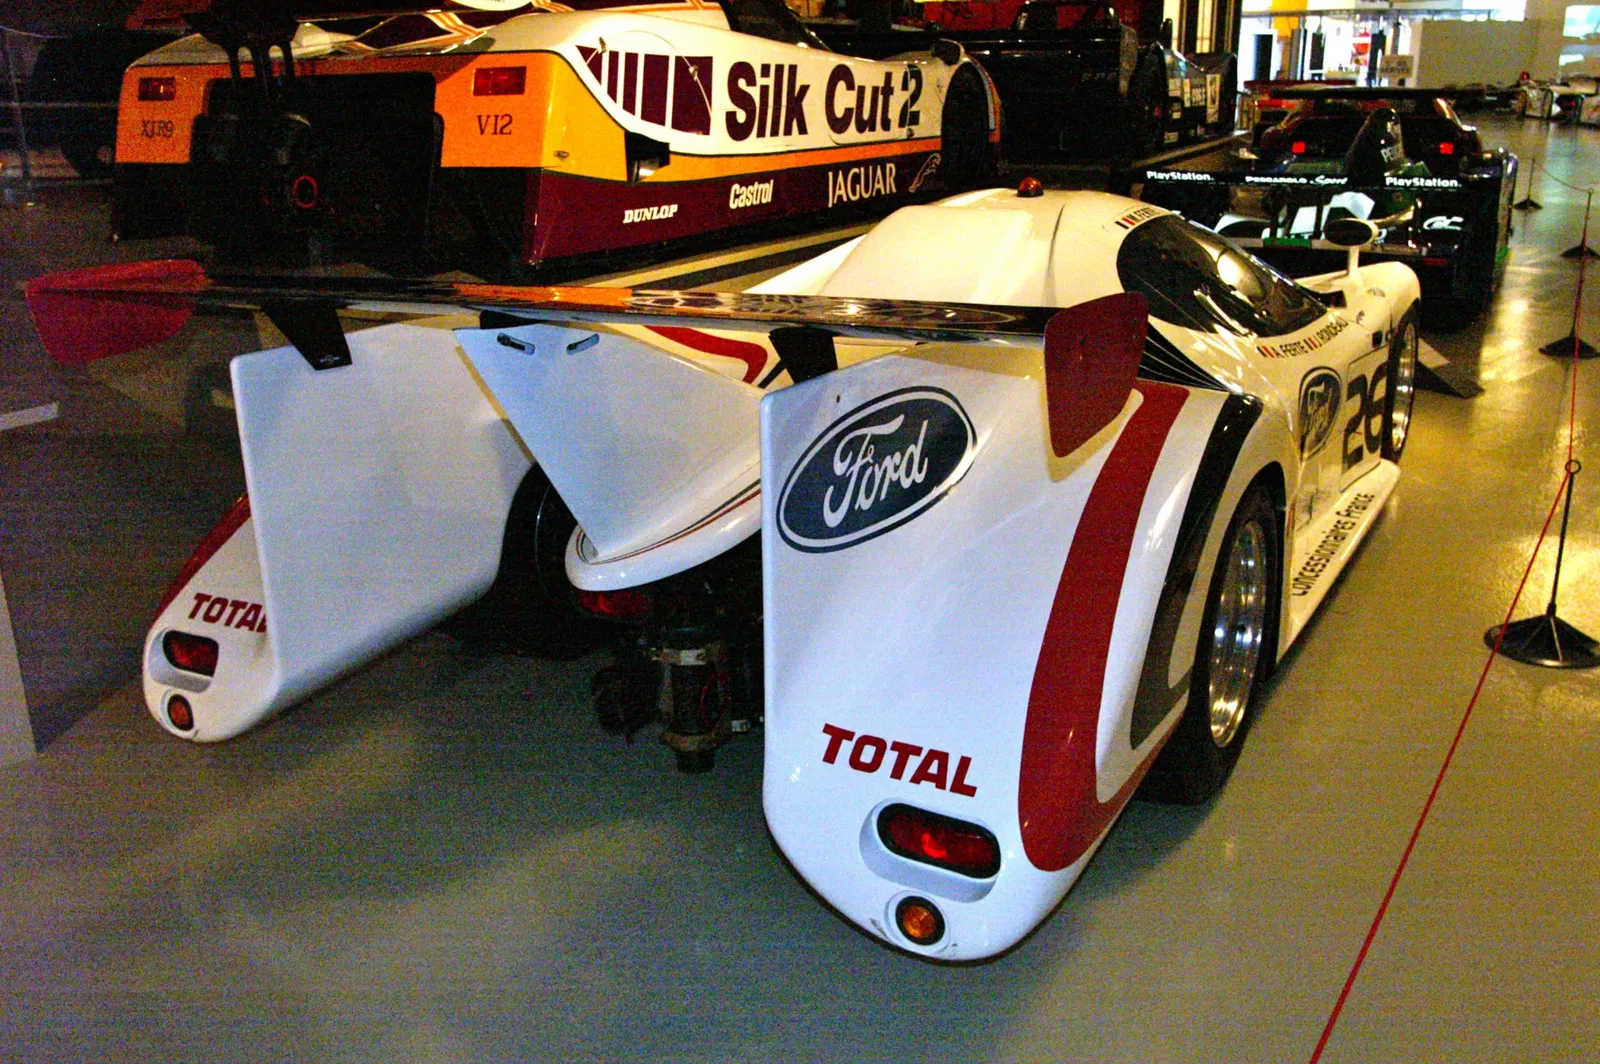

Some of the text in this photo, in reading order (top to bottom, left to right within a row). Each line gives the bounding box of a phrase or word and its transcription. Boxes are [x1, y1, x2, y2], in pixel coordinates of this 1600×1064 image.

[725, 60, 895, 142] Silk Cut
[898, 63, 924, 129] 2
[140, 118, 175, 138] XJR9
[476, 113, 514, 136] V12
[827, 162, 898, 208] JAGUAR
[1146, 170, 1212, 182] PlayStation
[1385, 176, 1460, 188] PlayStation
[729, 179, 774, 210] Castrol
[622, 204, 678, 224] DUNLOP
[823, 413, 929, 529] Ford
[1335, 493, 1375, 520] France
[822, 722, 977, 798] TOTAL
